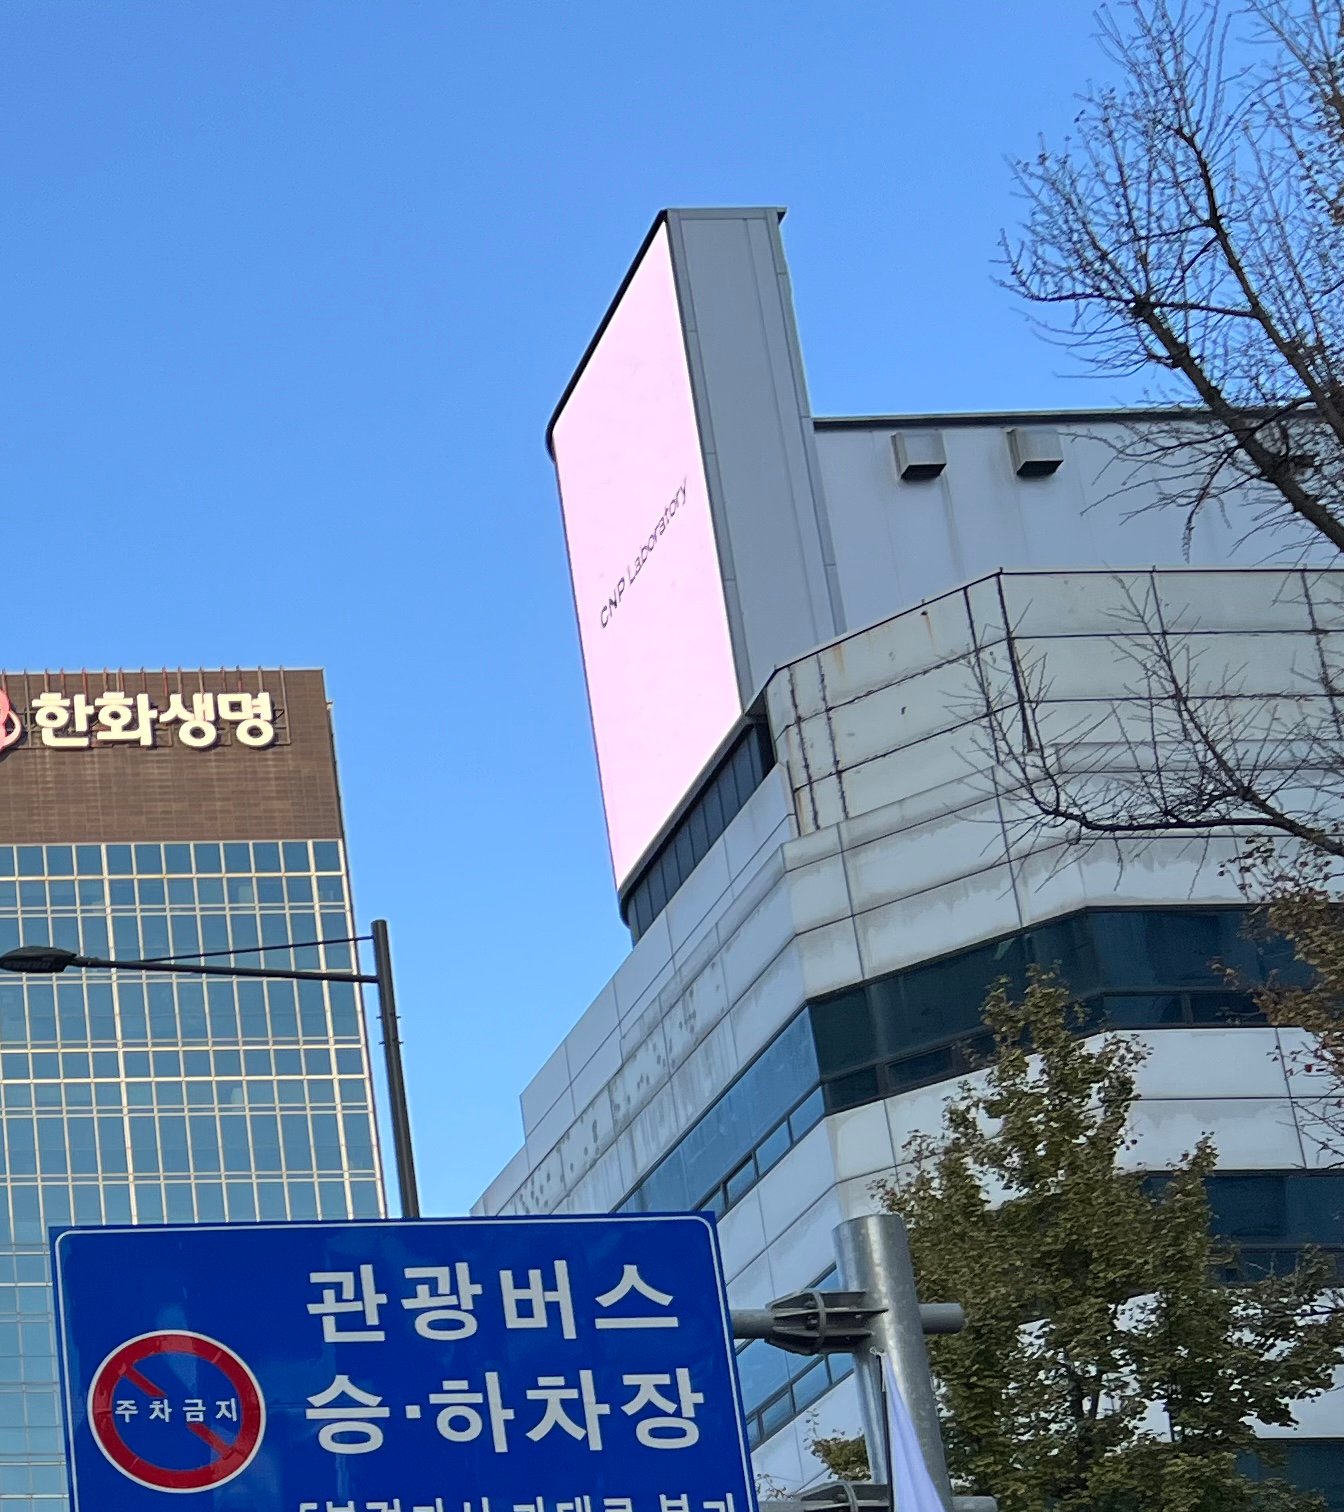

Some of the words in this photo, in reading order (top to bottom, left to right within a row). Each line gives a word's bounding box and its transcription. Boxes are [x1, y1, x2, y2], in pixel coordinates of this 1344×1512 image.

[599, 575, 627, 630] CNP
[626, 477, 689, 584] Laboratory
[31, 691, 275, 749] 한화생명
[305, 1260, 680, 1342] 관광버스
[114, 1398, 239, 1425] 주차금지
[305, 1366, 704, 1454] 승·하차장
